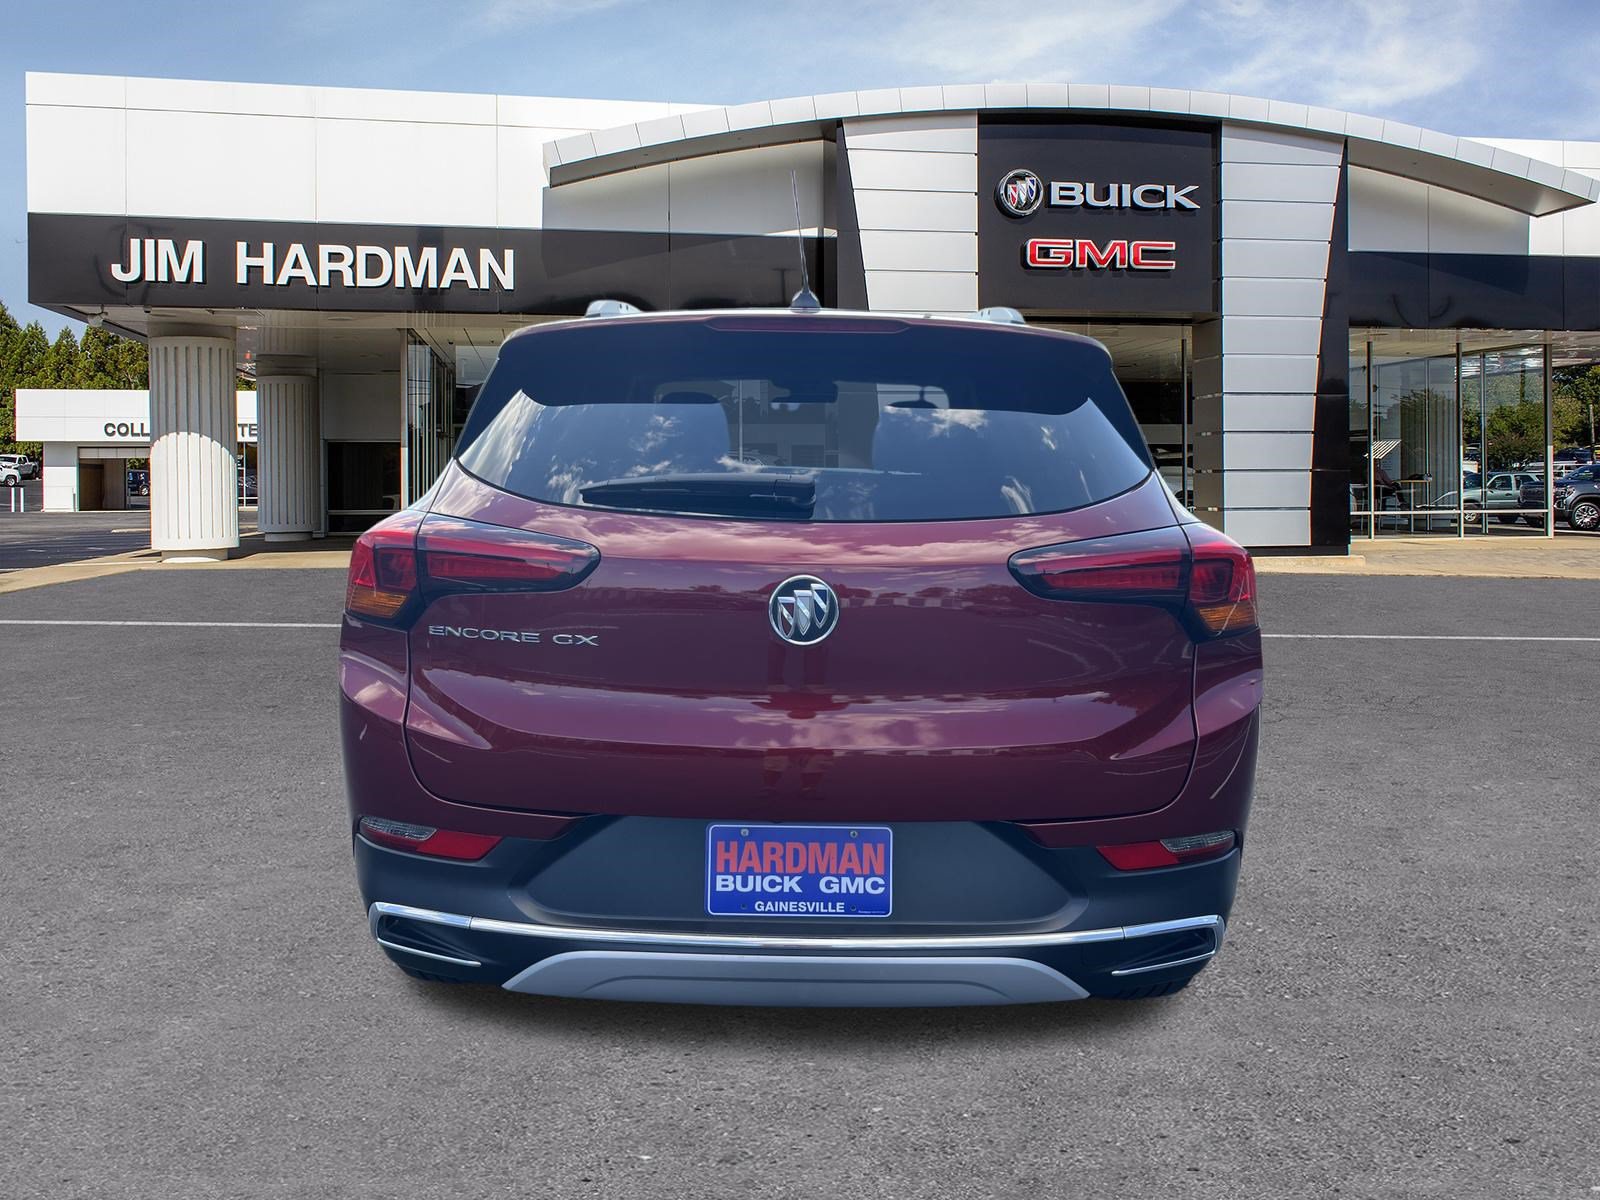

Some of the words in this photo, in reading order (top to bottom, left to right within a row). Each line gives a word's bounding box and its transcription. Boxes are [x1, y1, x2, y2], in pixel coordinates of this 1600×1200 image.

[1051, 181, 1200, 208] BUICK
[111, 238, 204, 283] JIM
[236, 241, 515, 290] HARDMAN
[1026, 238, 1176, 270] GMC
[428, 625, 541, 643] ENCORE
[552, 634, 599, 646] GX
[716, 840, 885, 875] HARDMAN
[715, 875, 803, 893] BUICK
[819, 876, 886, 895] GMC
[754, 901, 845, 913] GAINESVILLE
